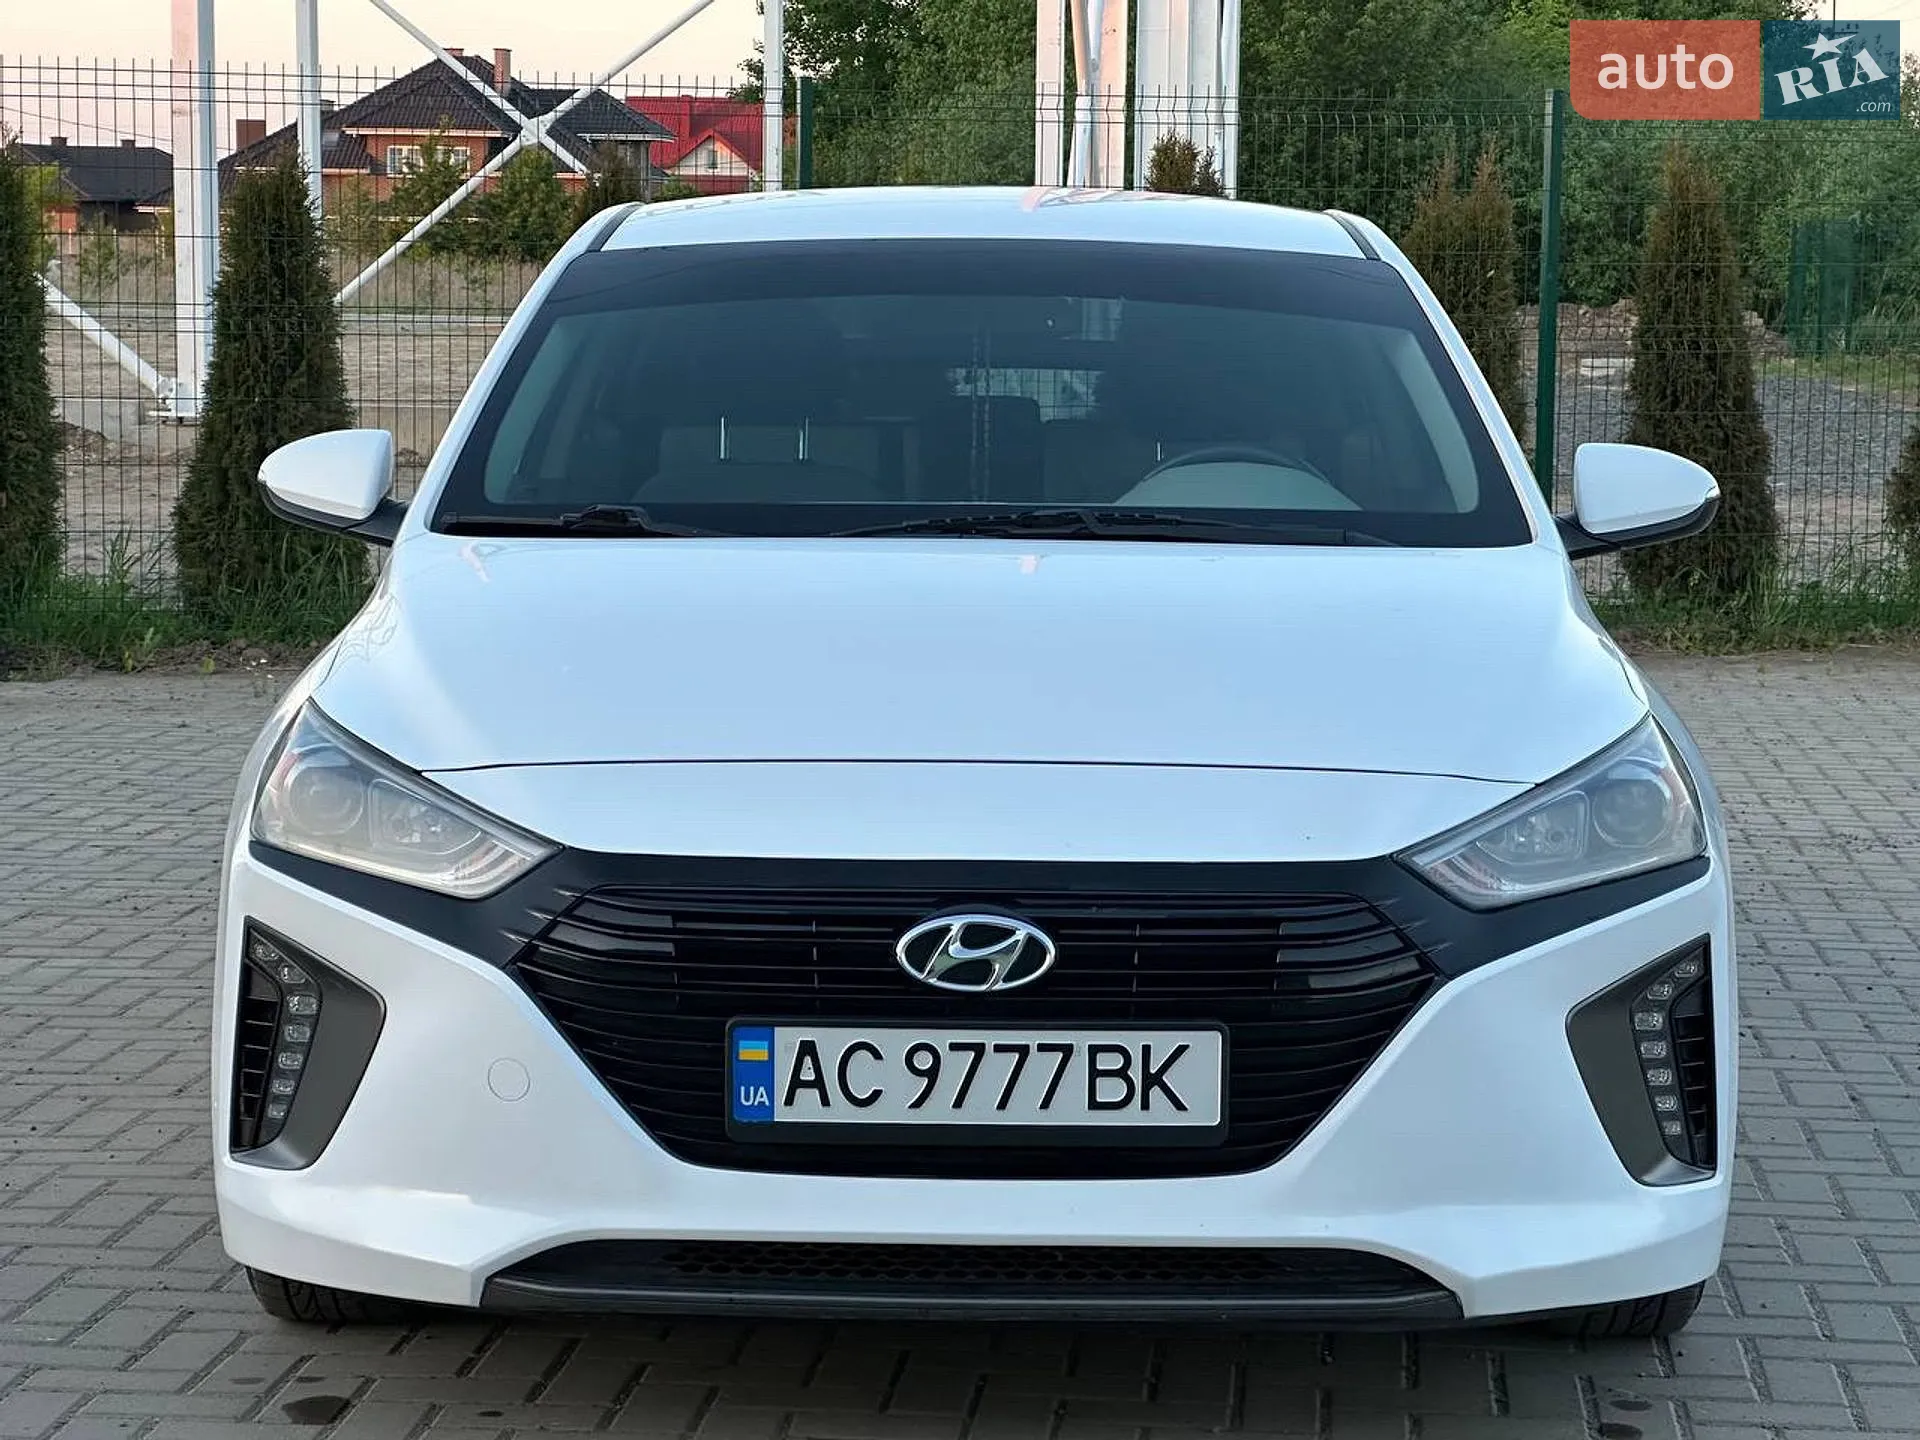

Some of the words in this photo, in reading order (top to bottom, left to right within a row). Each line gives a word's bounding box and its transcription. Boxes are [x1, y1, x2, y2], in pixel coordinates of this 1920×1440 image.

[740, 1086, 769, 1107] UA
[783, 1038, 884, 1109] AC
[904, 1041, 1075, 1110] 9777
[1086, 1043, 1190, 1112] BK
